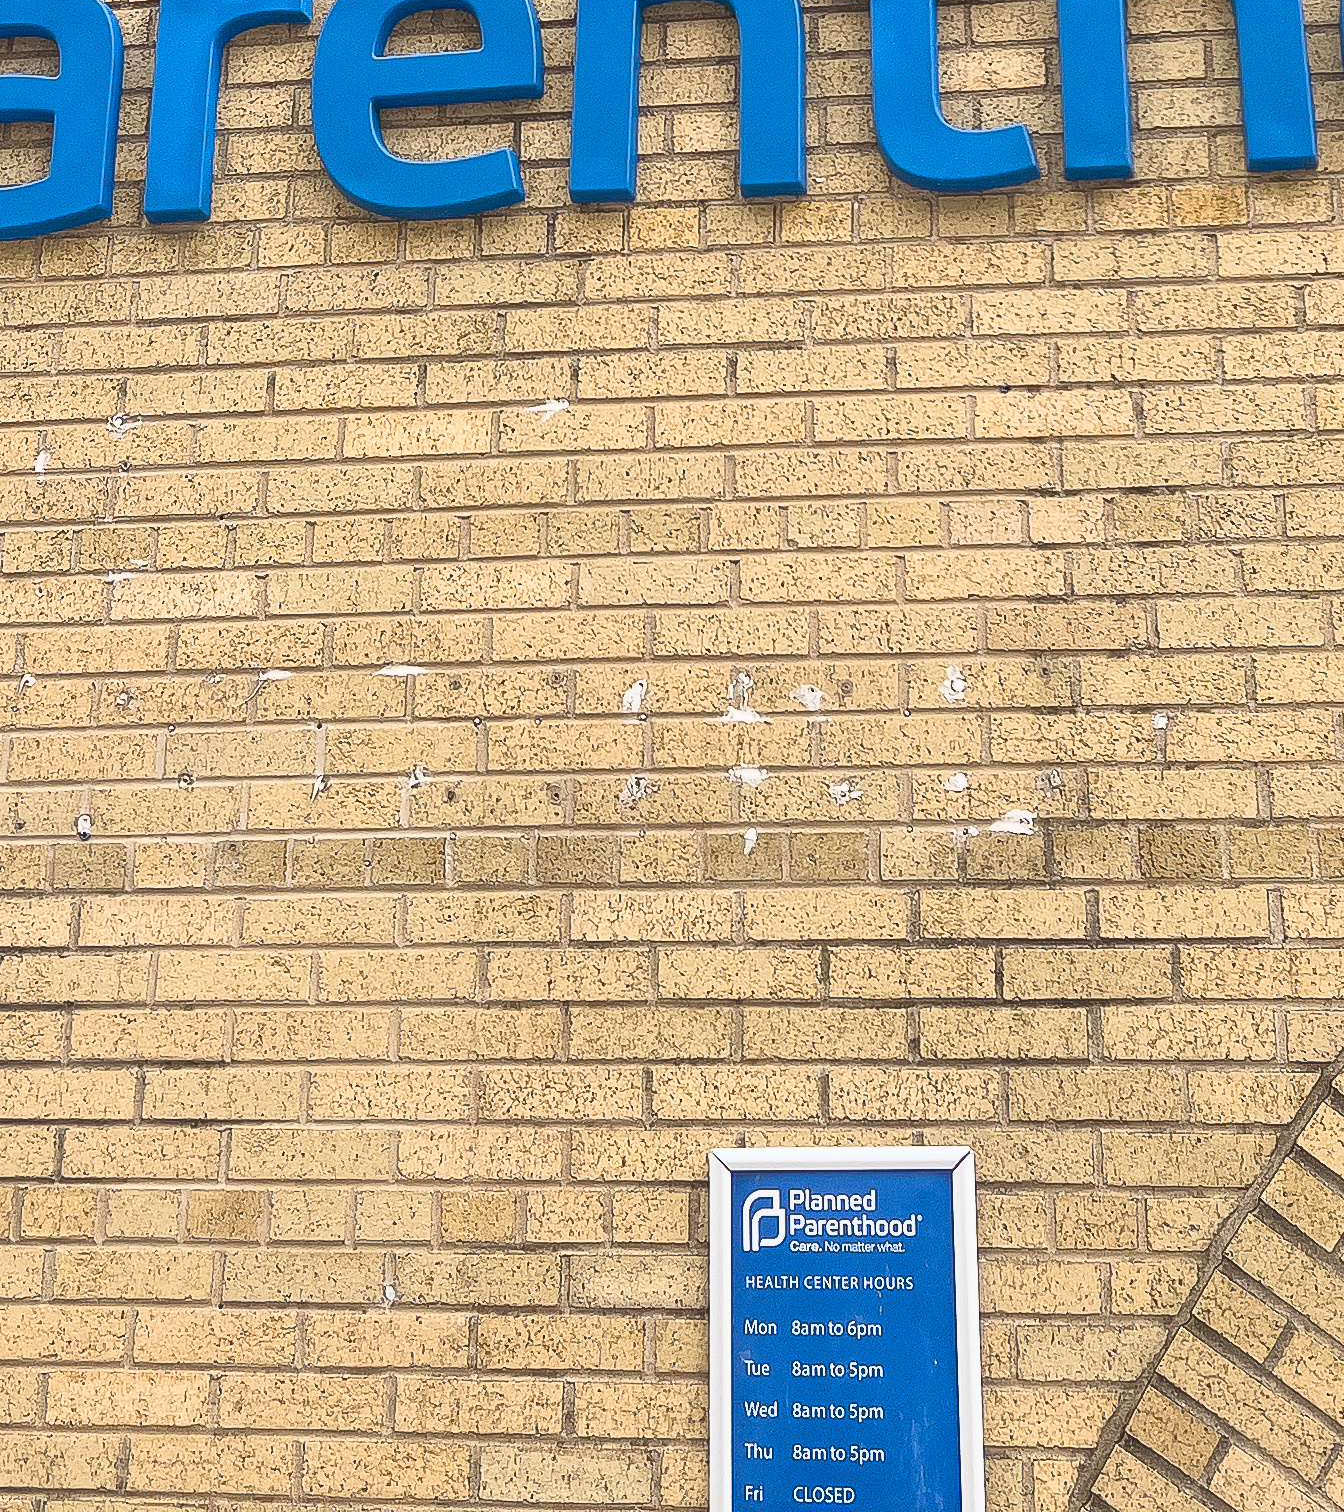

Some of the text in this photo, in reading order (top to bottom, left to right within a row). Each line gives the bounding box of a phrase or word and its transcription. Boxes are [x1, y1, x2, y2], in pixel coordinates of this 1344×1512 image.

[789, 1188, 877, 1212] Planned
[789, 1240, 906, 1253] Care. No matter what.
[745, 1275, 914, 1290] HEALTH CENTER HOURS
[744, 1319, 884, 1340] Mon 8am to 6pm
[744, 1359, 884, 1381] Tue 8am to 5pm
[744, 1400, 884, 1423] Wed 8am to 5pm
[744, 1442, 884, 1465] Thu 8am to 5pm
[744, 1485, 855, 1504] Fri CLOSED
